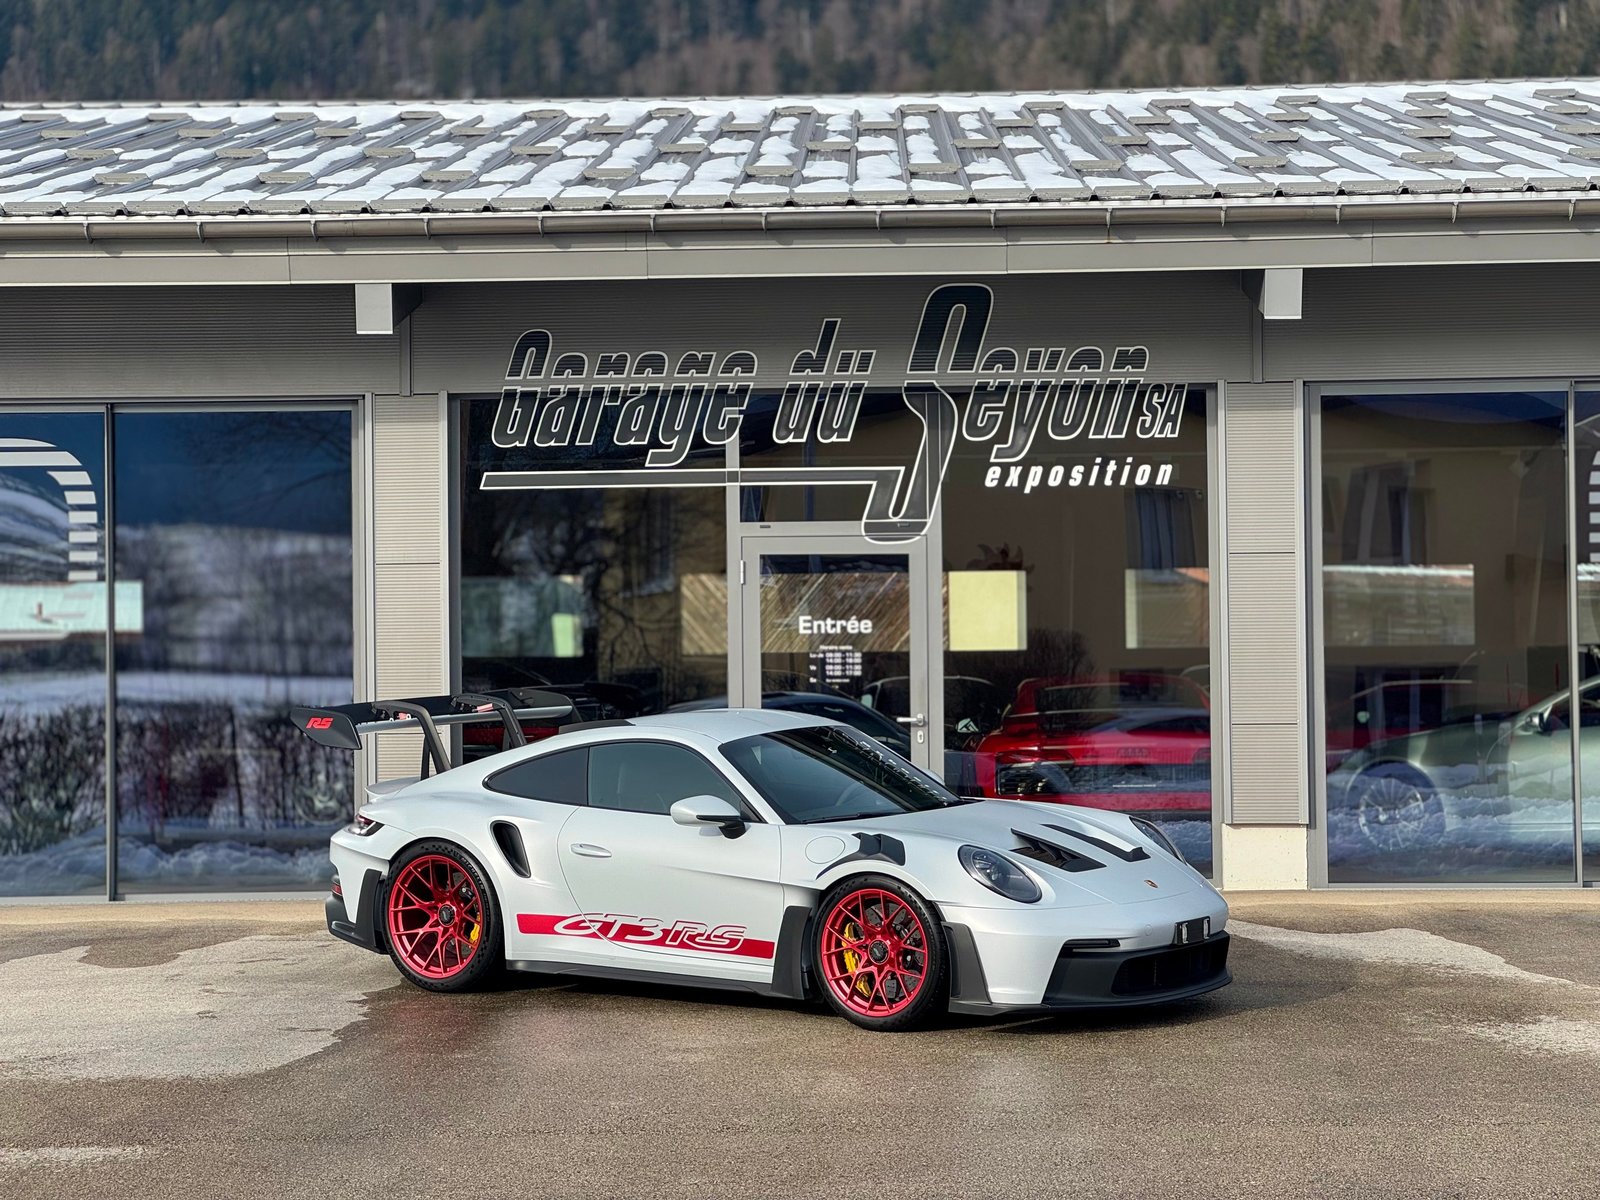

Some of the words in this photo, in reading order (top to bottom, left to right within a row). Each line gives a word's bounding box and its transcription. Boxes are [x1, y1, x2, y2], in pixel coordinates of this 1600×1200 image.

[491, 328, 759, 467] Garage
[772, 318, 876, 443] du
[861, 282, 1150, 545] Seyon
[1136, 382, 1187, 438] SA
[984, 456, 1173, 494] exposition
[798, 615, 873, 634] Entrée
[305, 717, 334, 729] RS
